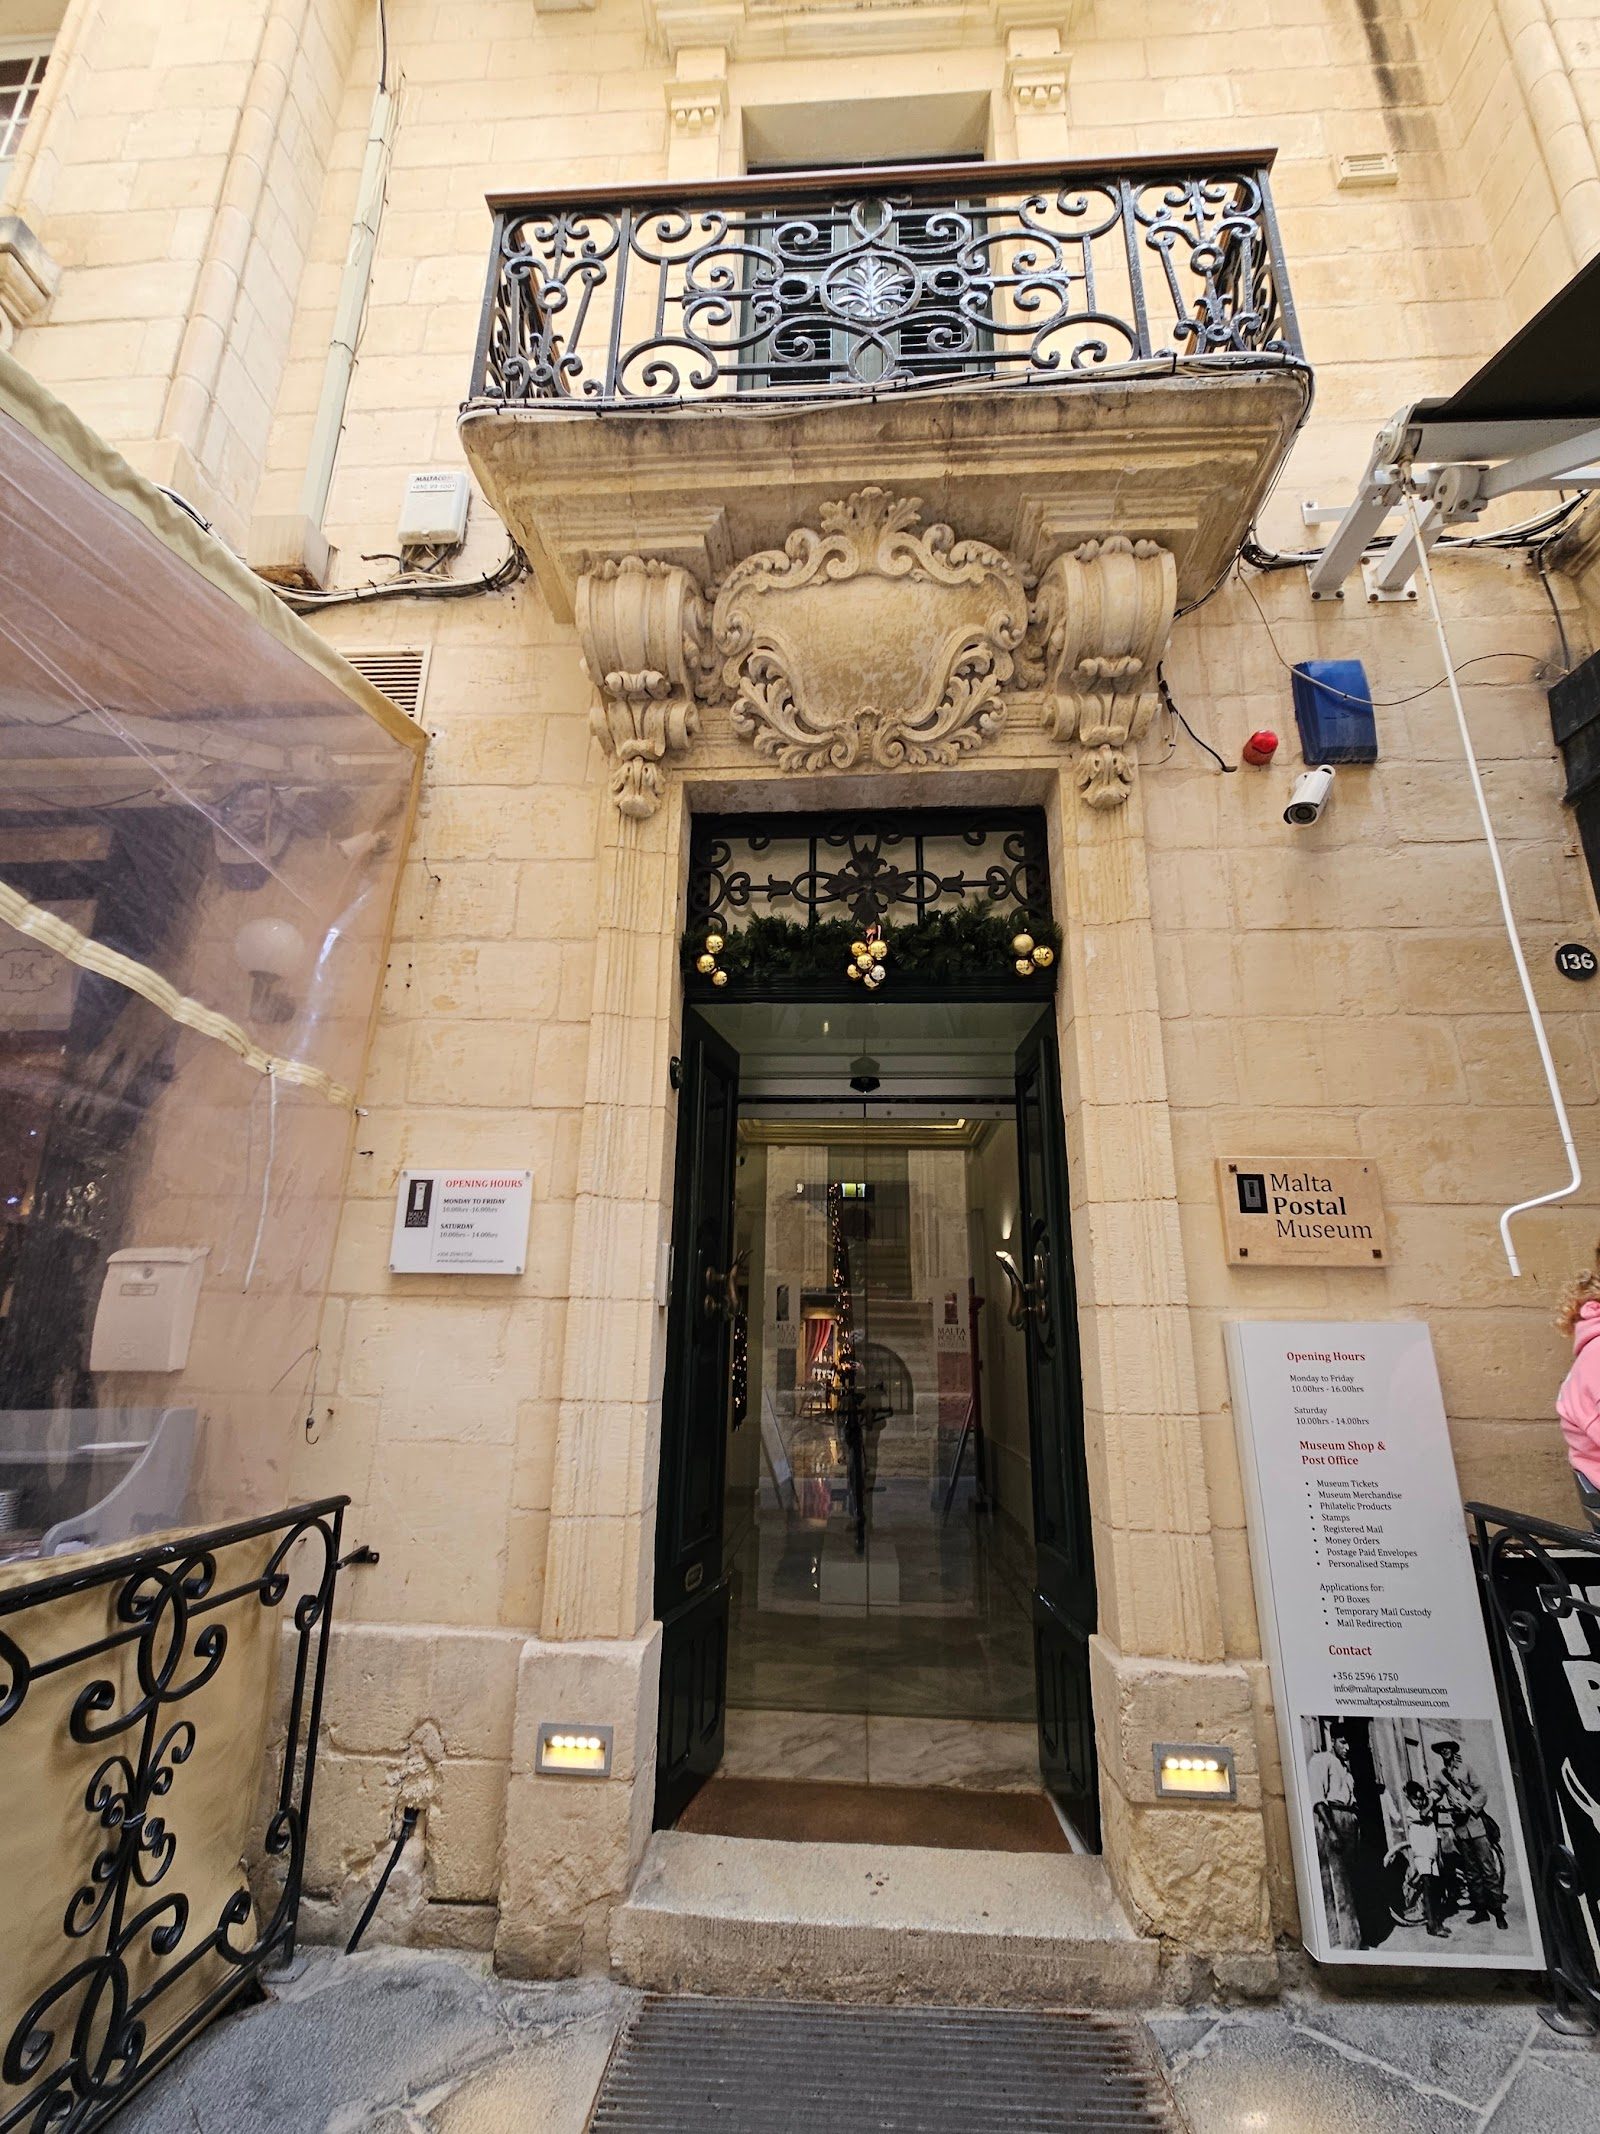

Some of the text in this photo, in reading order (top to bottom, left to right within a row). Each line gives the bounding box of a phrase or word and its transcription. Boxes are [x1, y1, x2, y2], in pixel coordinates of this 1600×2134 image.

[1560, 952, 1594, 969] 136
[446, 1180, 523, 1188] OPENING HOURS
[1270, 1173, 1333, 1192] Malta
[1273, 1197, 1347, 1215] Postal
[1276, 1219, 1373, 1239] Museum
[1287, 1351, 1366, 1363] Opening Hours
[1289, 1375, 1320, 1383] Monday
[1330, 1375, 1354, 1384] Friday
[1292, 1385, 1324, 1393] 10.00hrs
[1331, 1385, 1364, 1393] 16.00hrs
[1294, 1406, 1327, 1416] Saturday
[1300, 1441, 1386, 1453] Museum Shop &
[1302, 1455, 1359, 1465] Post Office
[1317, 1480, 1379, 1488] Museum Tickets
[1318, 1491, 1402, 1500] Museum Merchandise
[1320, 1502, 1392, 1511] Philatelic Products
[1322, 1514, 1350, 1522] Stamps
[1323, 1525, 1384, 1534] Registered Mail
[1325, 1537, 1380, 1546] Money Orders
[1327, 1548, 1418, 1558] Postage Paid Envelopes
[1328, 1560, 1409, 1570] Personalised Stamps
[1320, 1583, 1384, 1594] Applications for:
[1333, 1595, 1370, 1604] PO Boxes
[1335, 1608, 1432, 1618] Temporary Mail Custody
[1337, 1619, 1402, 1628] Mail Redirection
[1329, 1645, 1372, 1656] Contact
[1333, 1672, 1399, 1681] +356 2596 1750
[1334, 1684, 1448, 1695] info@maltapostalmuseum.com
[1335, 1697, 1450, 1708] www.maltapostalmuseum.com
